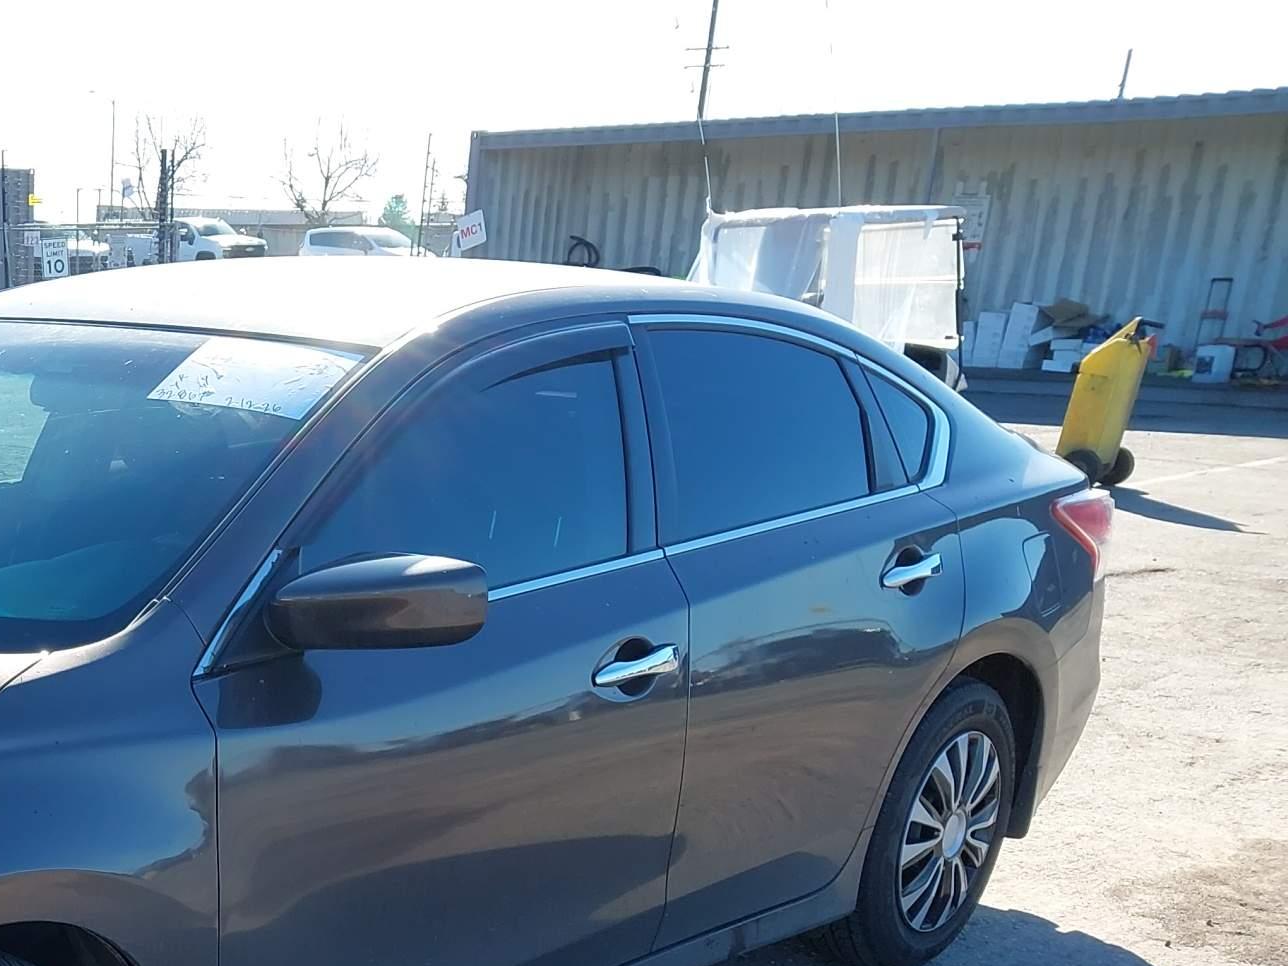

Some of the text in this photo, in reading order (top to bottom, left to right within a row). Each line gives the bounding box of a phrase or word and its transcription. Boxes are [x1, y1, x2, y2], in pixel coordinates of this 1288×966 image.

[460, 221, 483, 240] MC1
[44, 241, 66, 249] SPEED
[46, 250, 64, 258] LIMIT
[46, 258, 65, 274] 10
